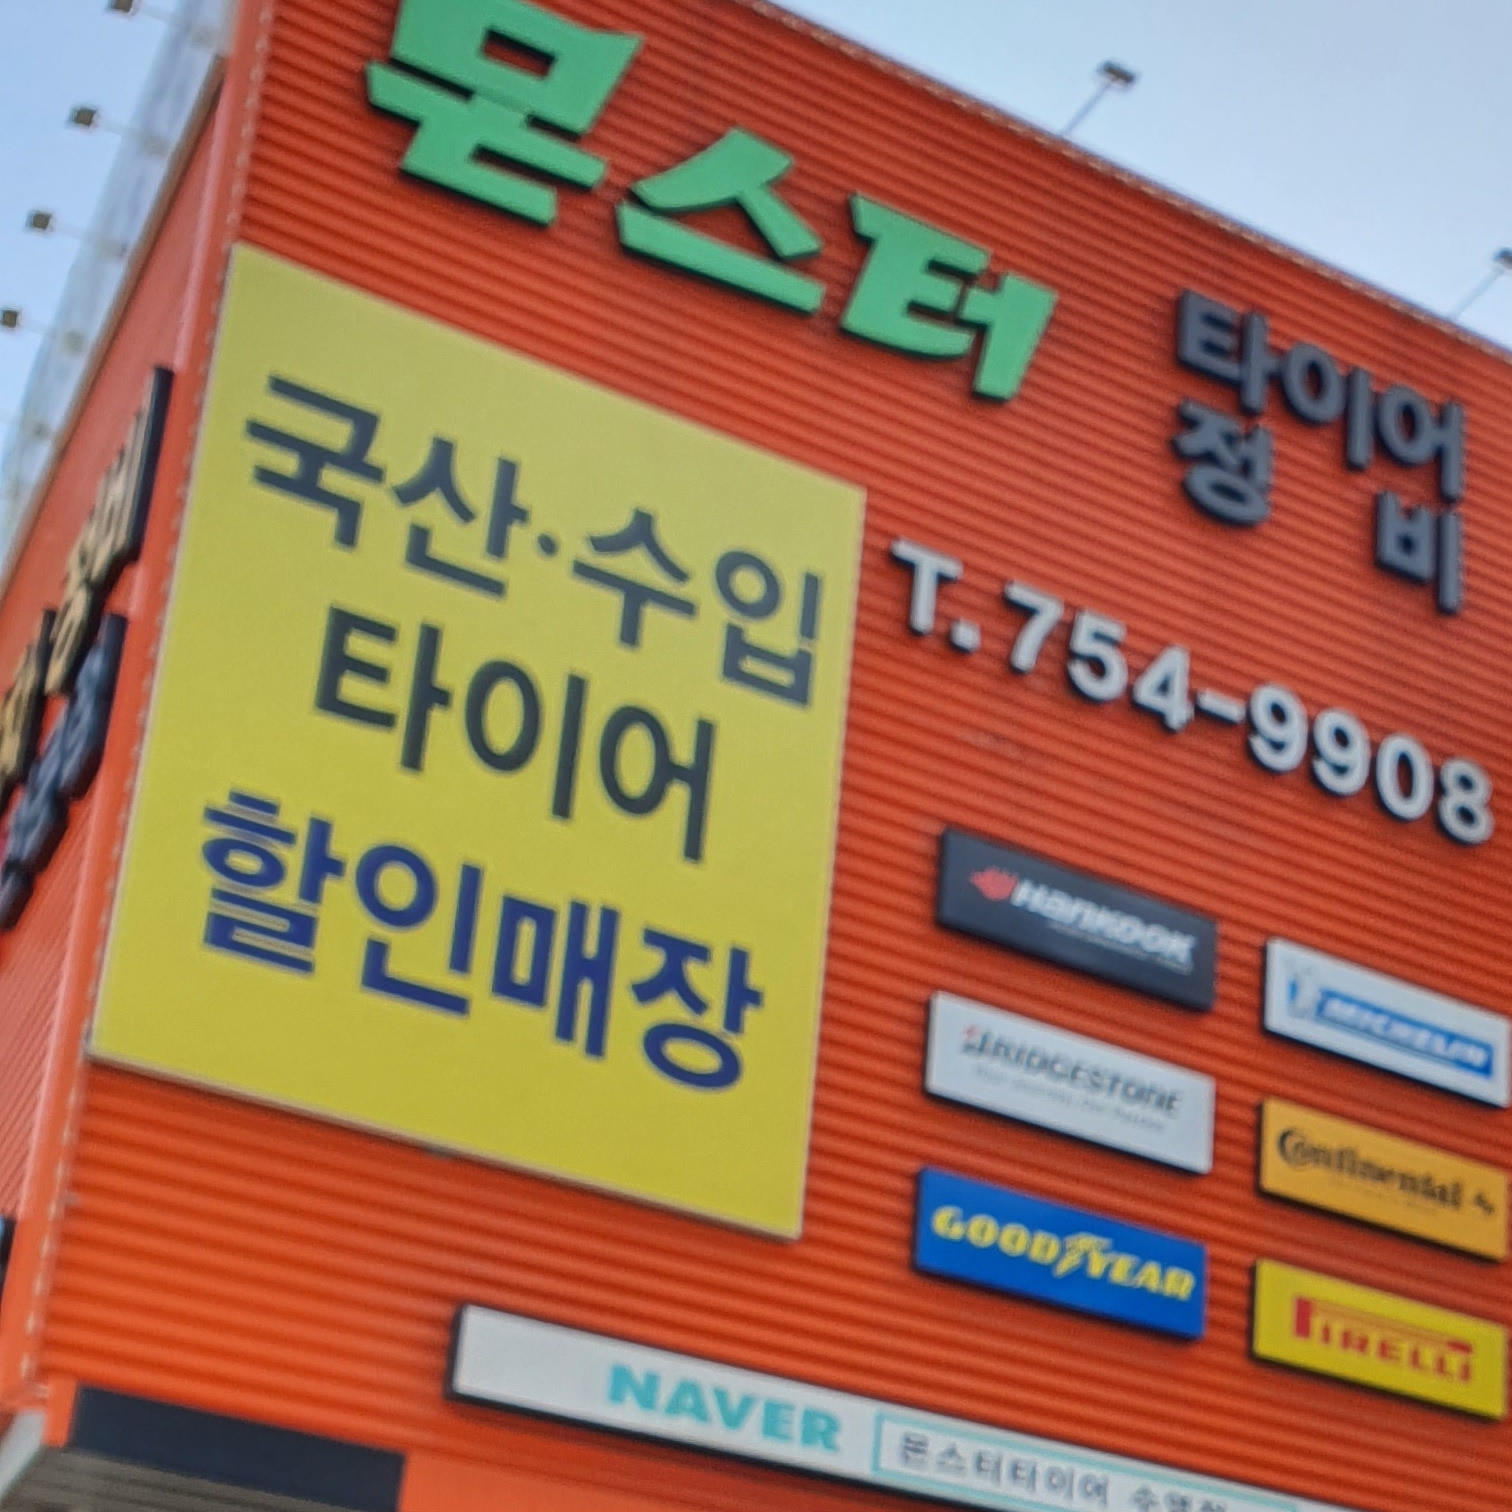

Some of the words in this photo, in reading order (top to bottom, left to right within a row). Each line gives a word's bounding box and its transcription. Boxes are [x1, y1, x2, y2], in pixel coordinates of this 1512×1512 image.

[364, 0, 1058, 403] 몬스터
[1177, 289, 1466, 502] 타이어
[246, 373, 822, 708] 국산·수입
[314, 603, 717, 864] 타이어
[201, 789, 764, 1092] 할인매장
[1277, 1129, 1463, 1210] Continental
[931, 1205, 1196, 1302] GOODYEAR
[608, 1362, 841, 1454] NAVER
[1294, 1296, 1474, 1384] PIRELLI
[900, 1430, 1110, 1508] 몬스터타이어
